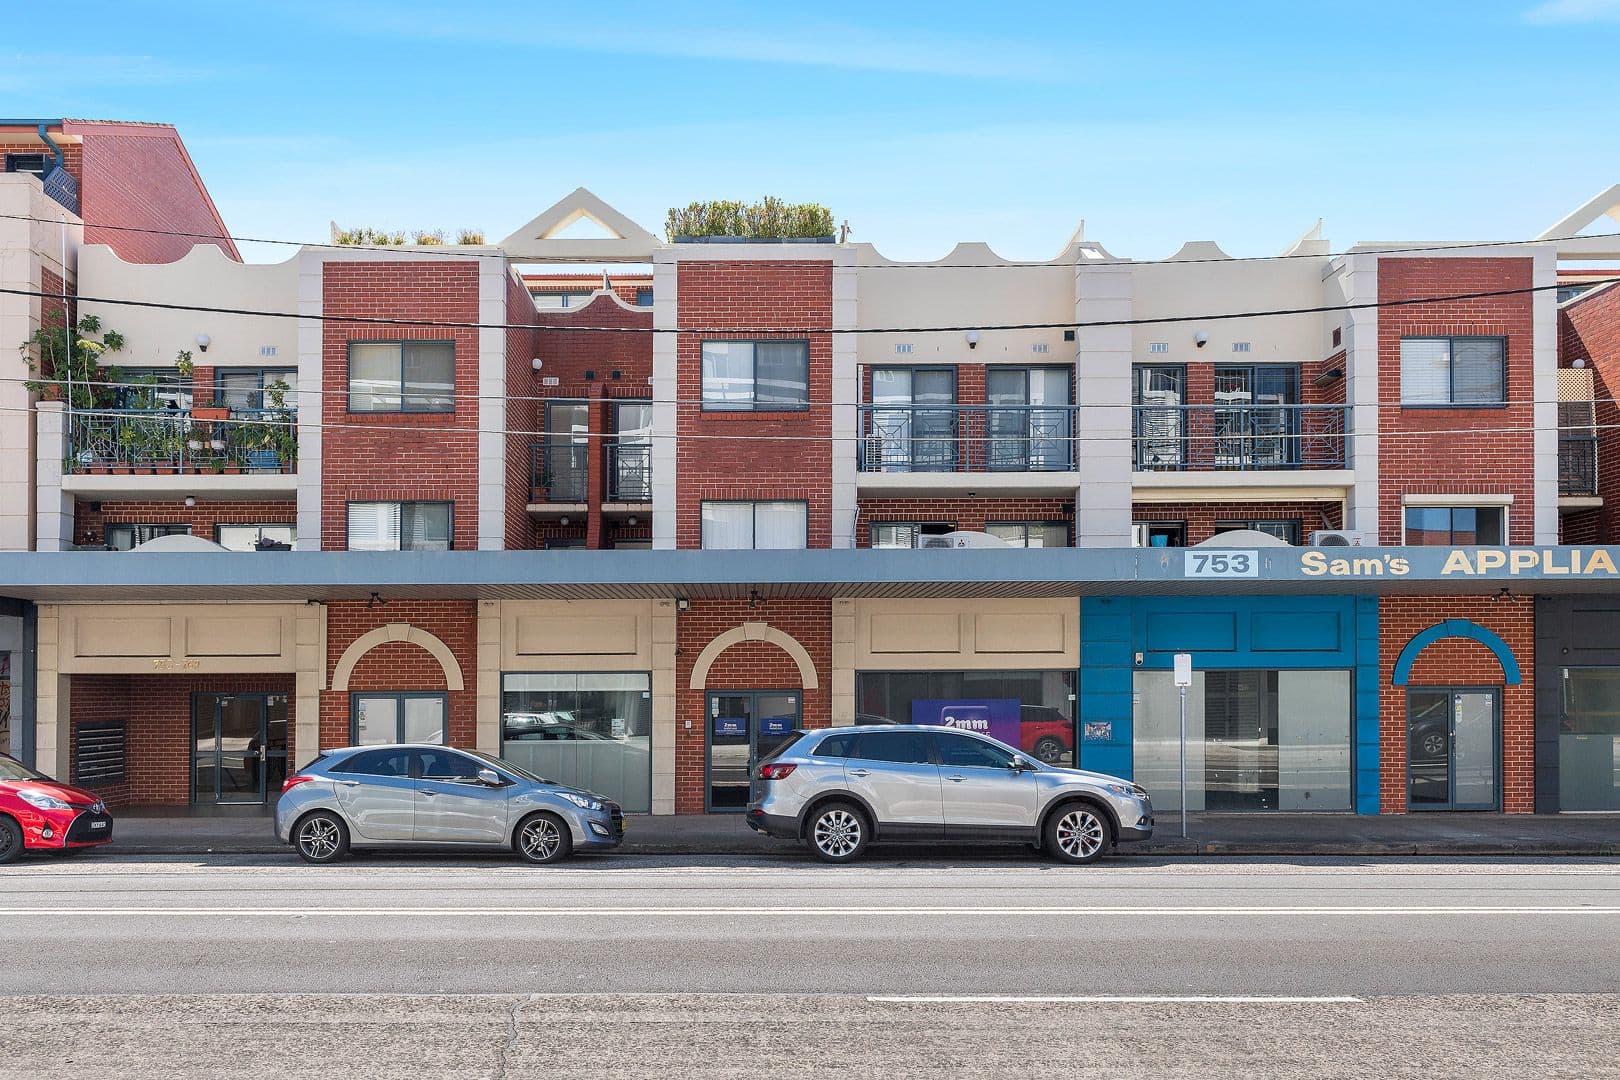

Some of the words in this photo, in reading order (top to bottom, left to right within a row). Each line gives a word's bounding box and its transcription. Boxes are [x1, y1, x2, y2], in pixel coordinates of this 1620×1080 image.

[1193, 553, 1250, 573] 753
[1301, 551, 1410, 576] Sam's
[1441, 550, 1618, 575] APPLIA
[944, 716, 989, 730] 2mm
